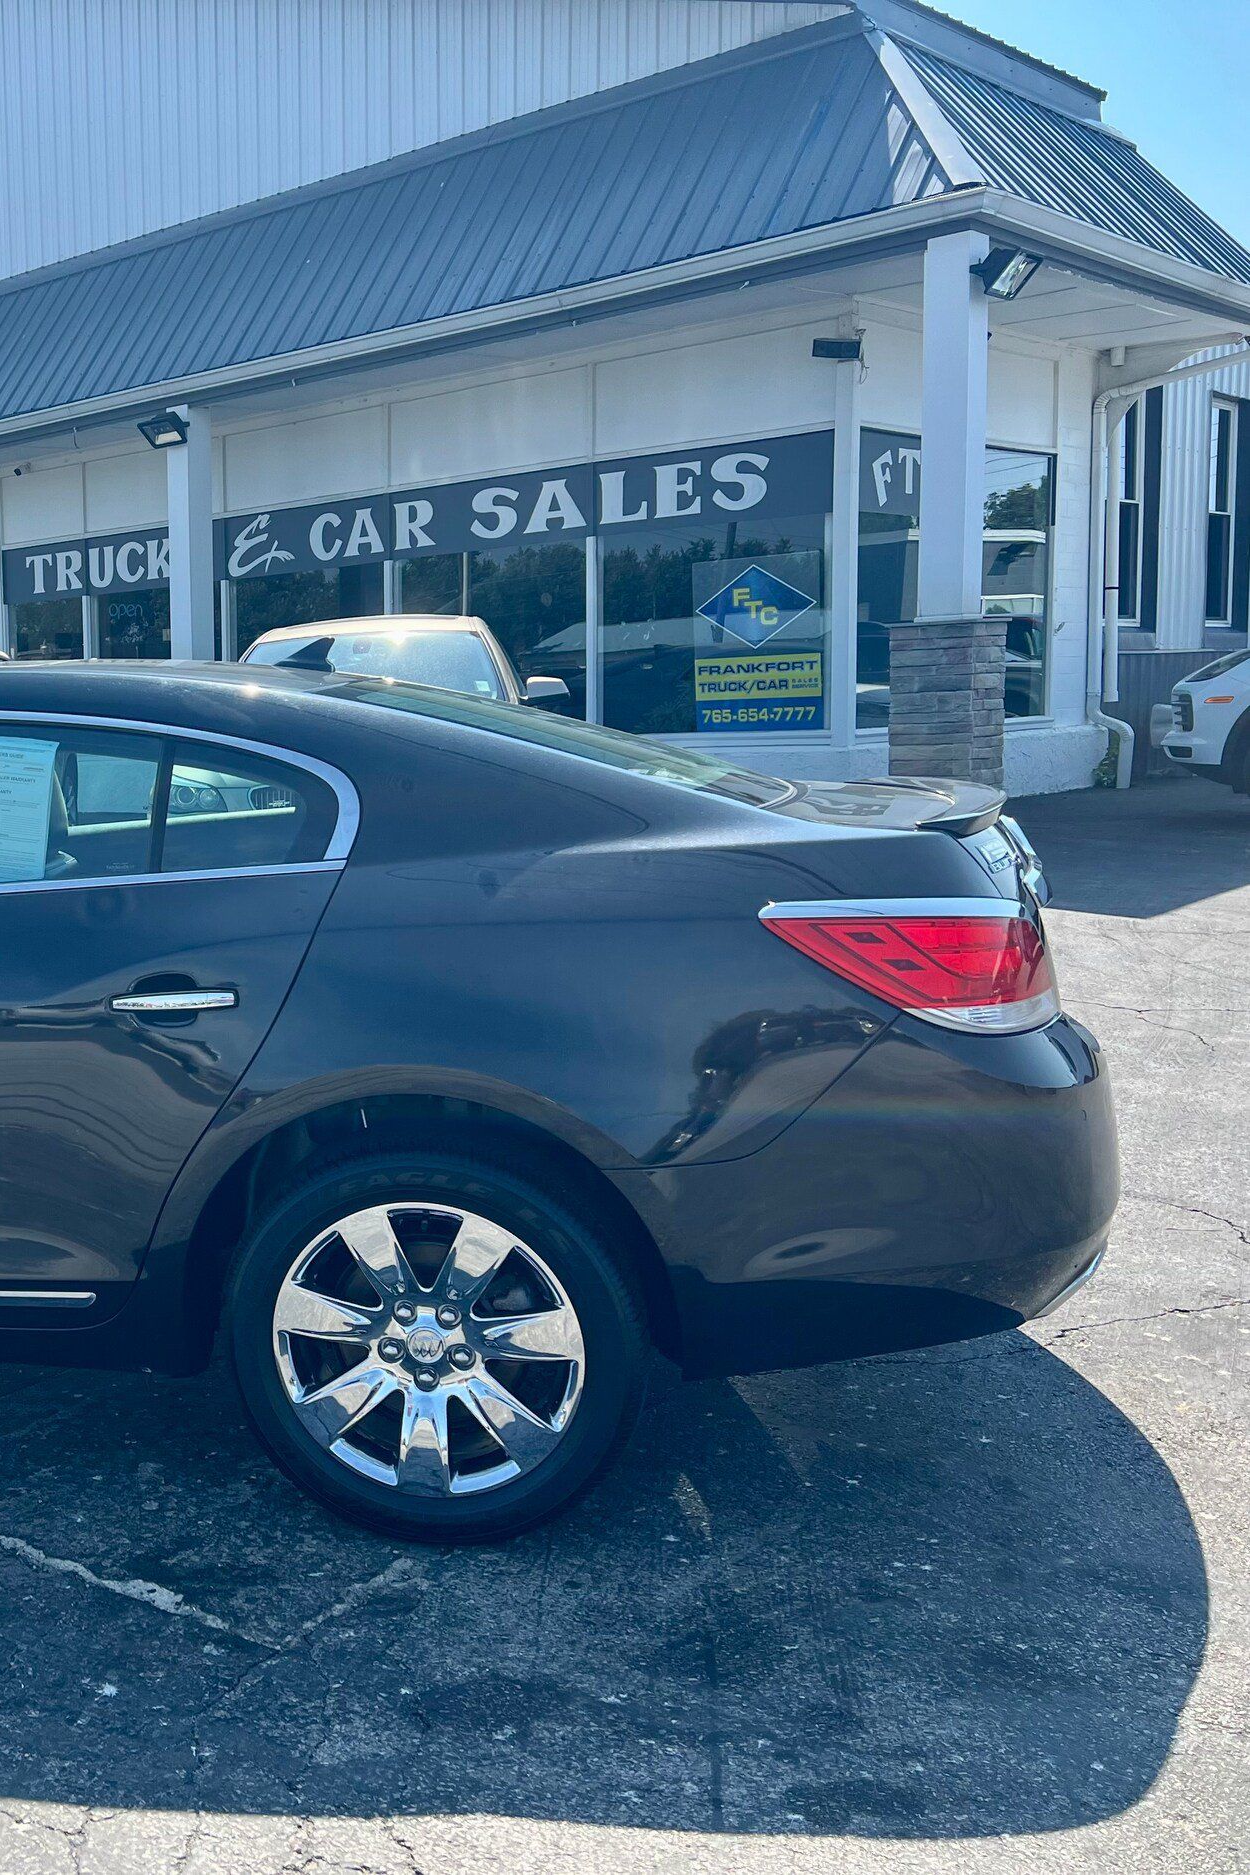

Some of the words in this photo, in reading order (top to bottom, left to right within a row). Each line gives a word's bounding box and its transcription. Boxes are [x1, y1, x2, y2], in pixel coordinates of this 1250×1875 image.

[25, 538, 170, 595] TRUCK
[309, 499, 437, 561] CAR
[470, 452, 770, 540] SALES
[109, 603, 143, 620] open
[732, 588, 778, 625] FTC
[698, 660, 818, 676] FRANKFORT
[699, 679, 789, 694] TRUCK/CAR
[702, 706, 816, 724] 765-654-7777
